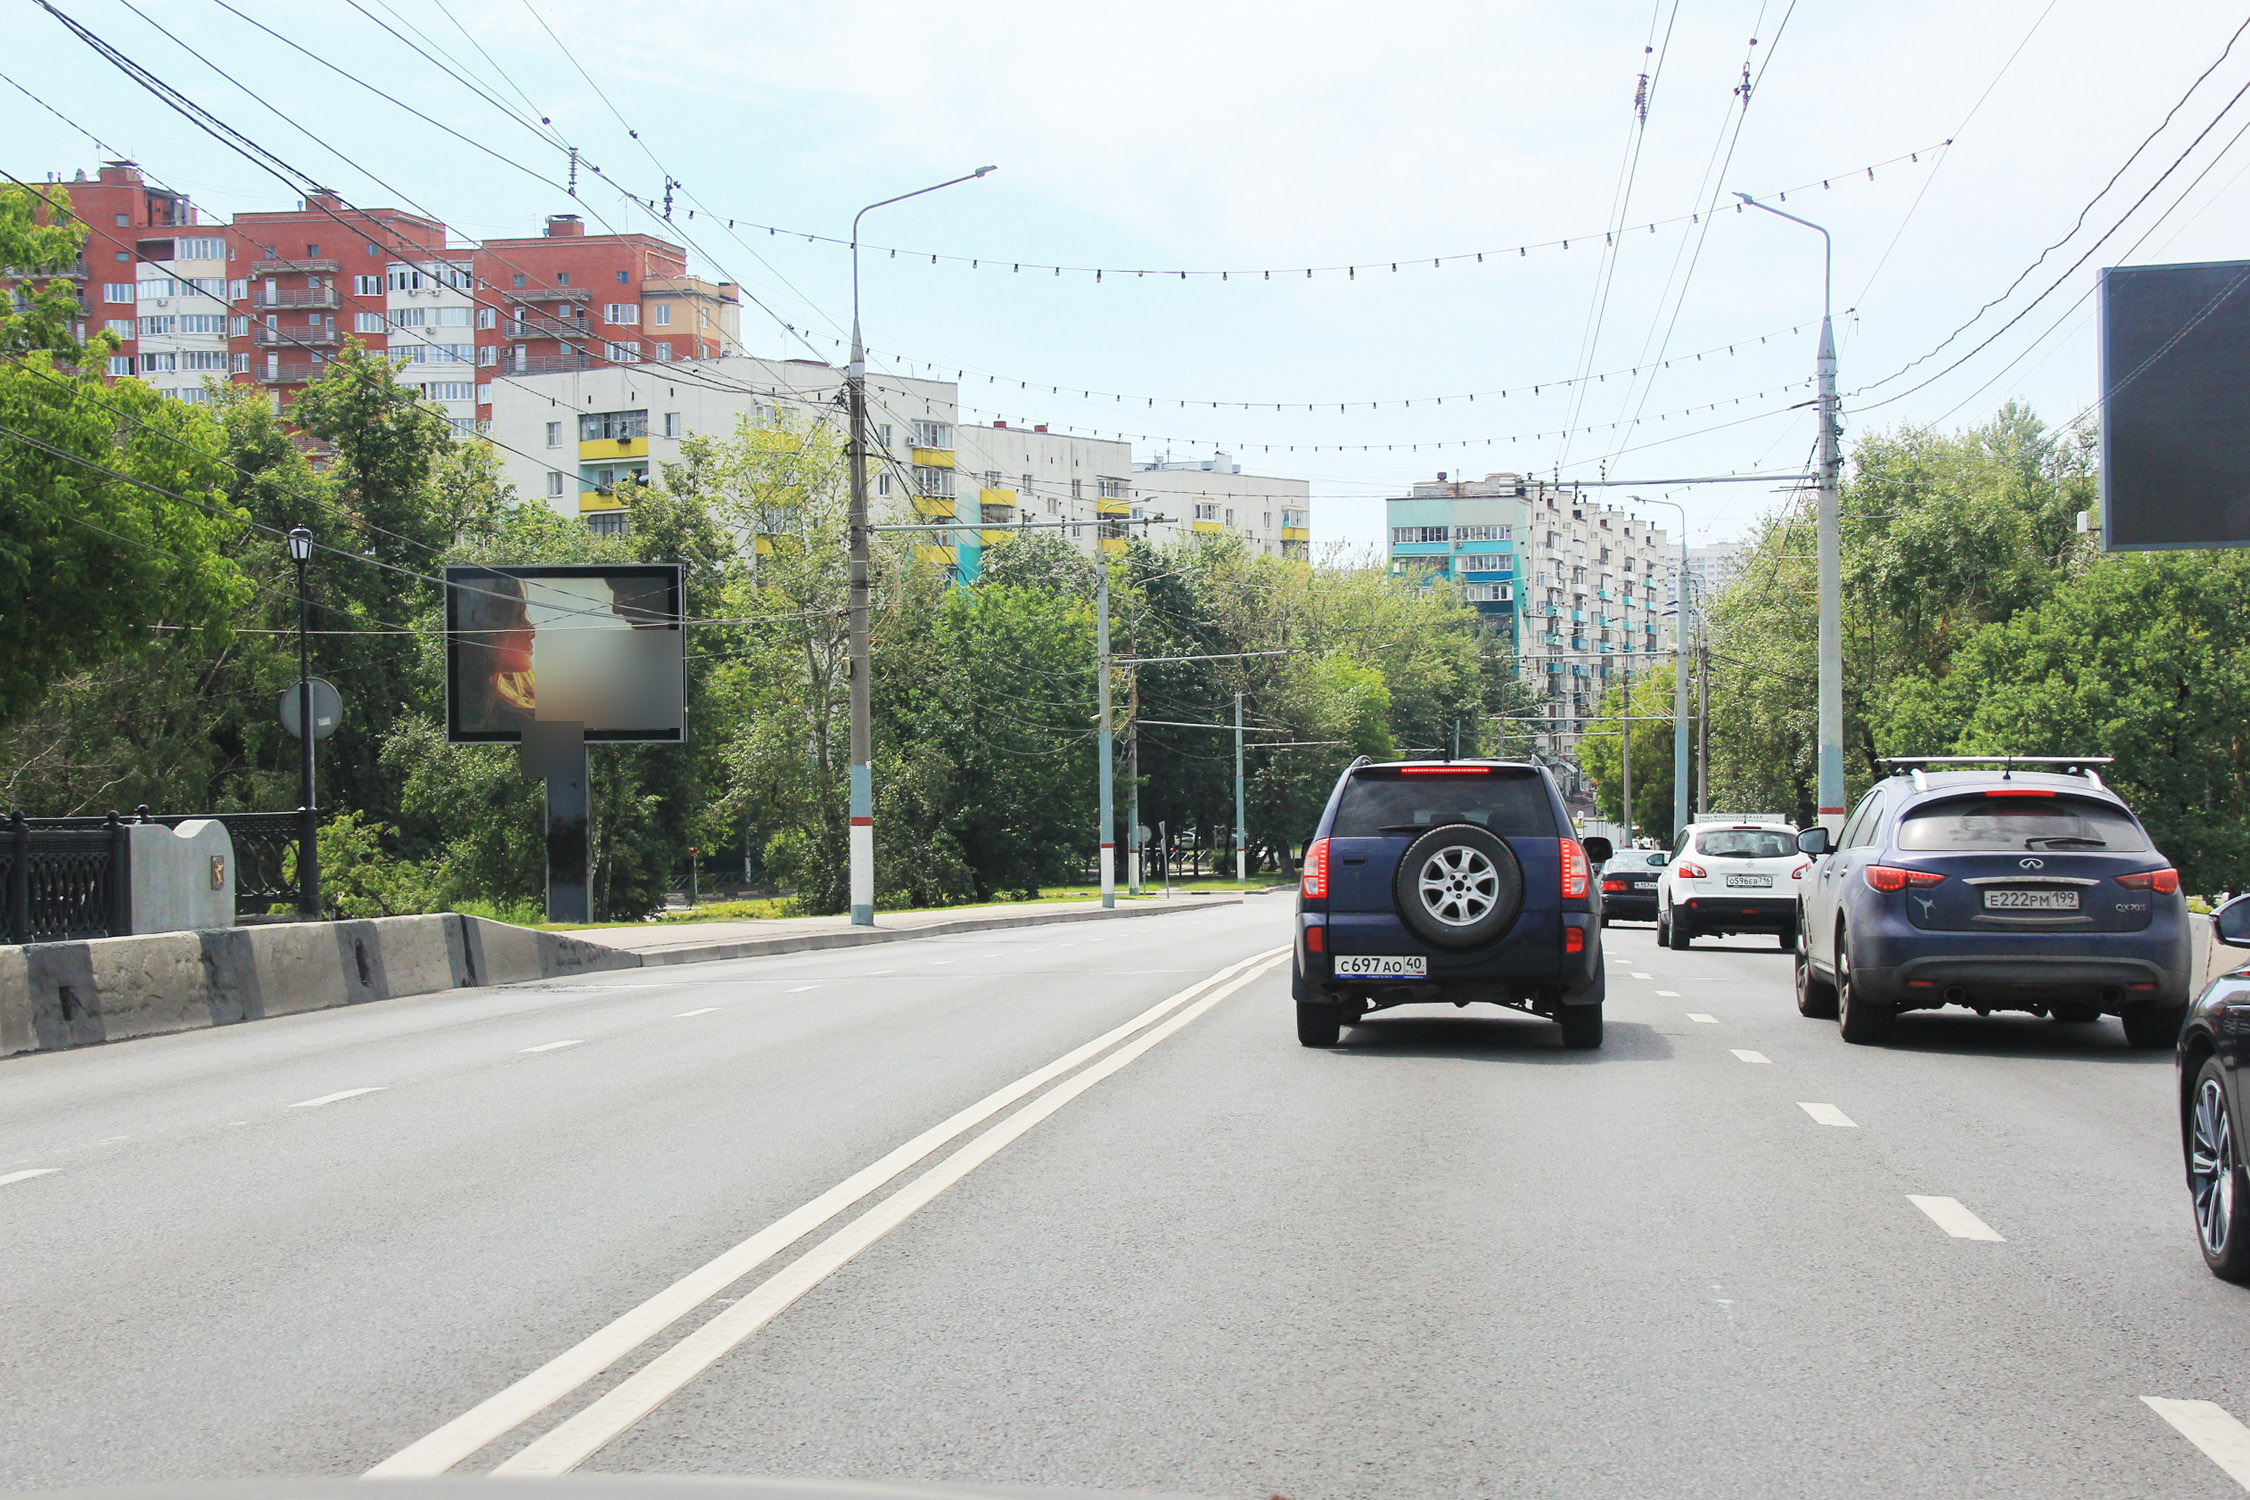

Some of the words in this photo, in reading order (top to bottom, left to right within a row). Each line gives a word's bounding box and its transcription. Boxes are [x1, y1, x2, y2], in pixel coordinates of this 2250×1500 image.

[1990, 892, 2049, 907] Е222РМ
[2052, 892, 2075, 904] 199
[1341, 957, 1402, 973] С697АО
[1406, 957, 1422, 969] 40
